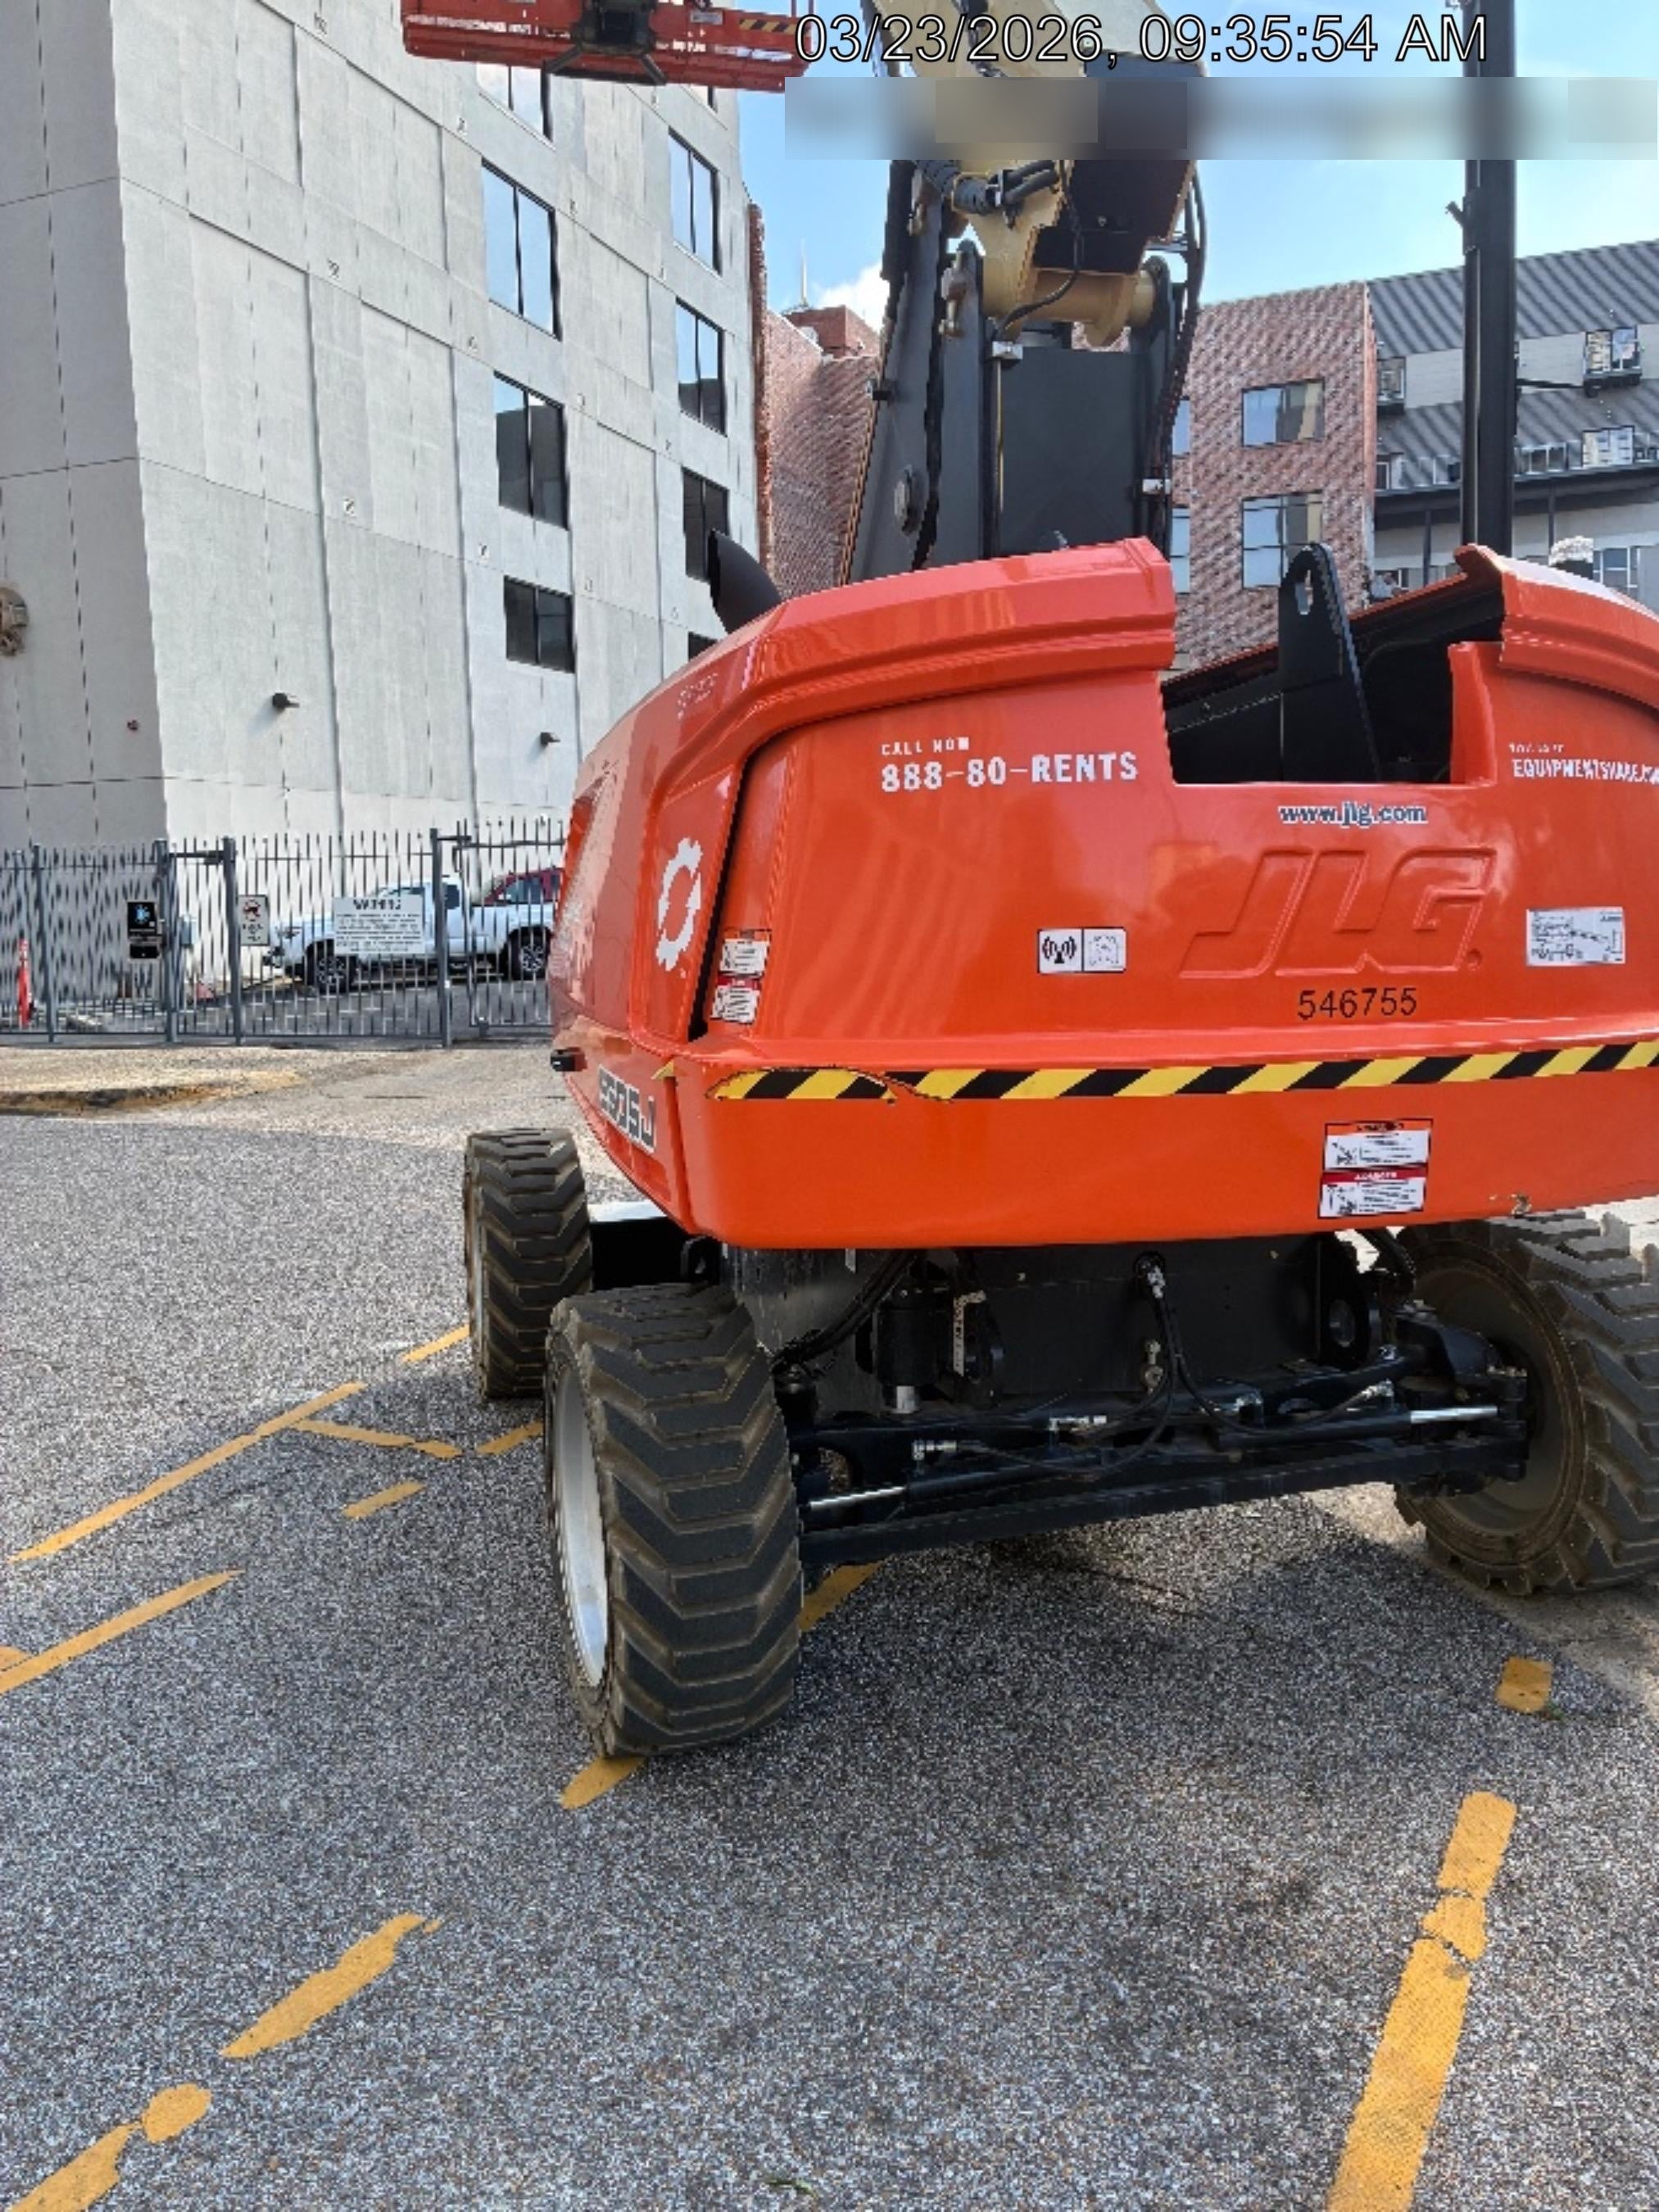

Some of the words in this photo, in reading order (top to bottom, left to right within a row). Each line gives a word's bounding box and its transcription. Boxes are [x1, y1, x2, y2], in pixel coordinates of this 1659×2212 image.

[881, 741, 922, 756] CALL
[882, 751, 1137, 793] 888-80-RENTS
[1278, 802, 1428, 827] www.jlg.com
[1180, 849, 1498, 978] JLG
[1298, 987, 1418, 1020] 546755
